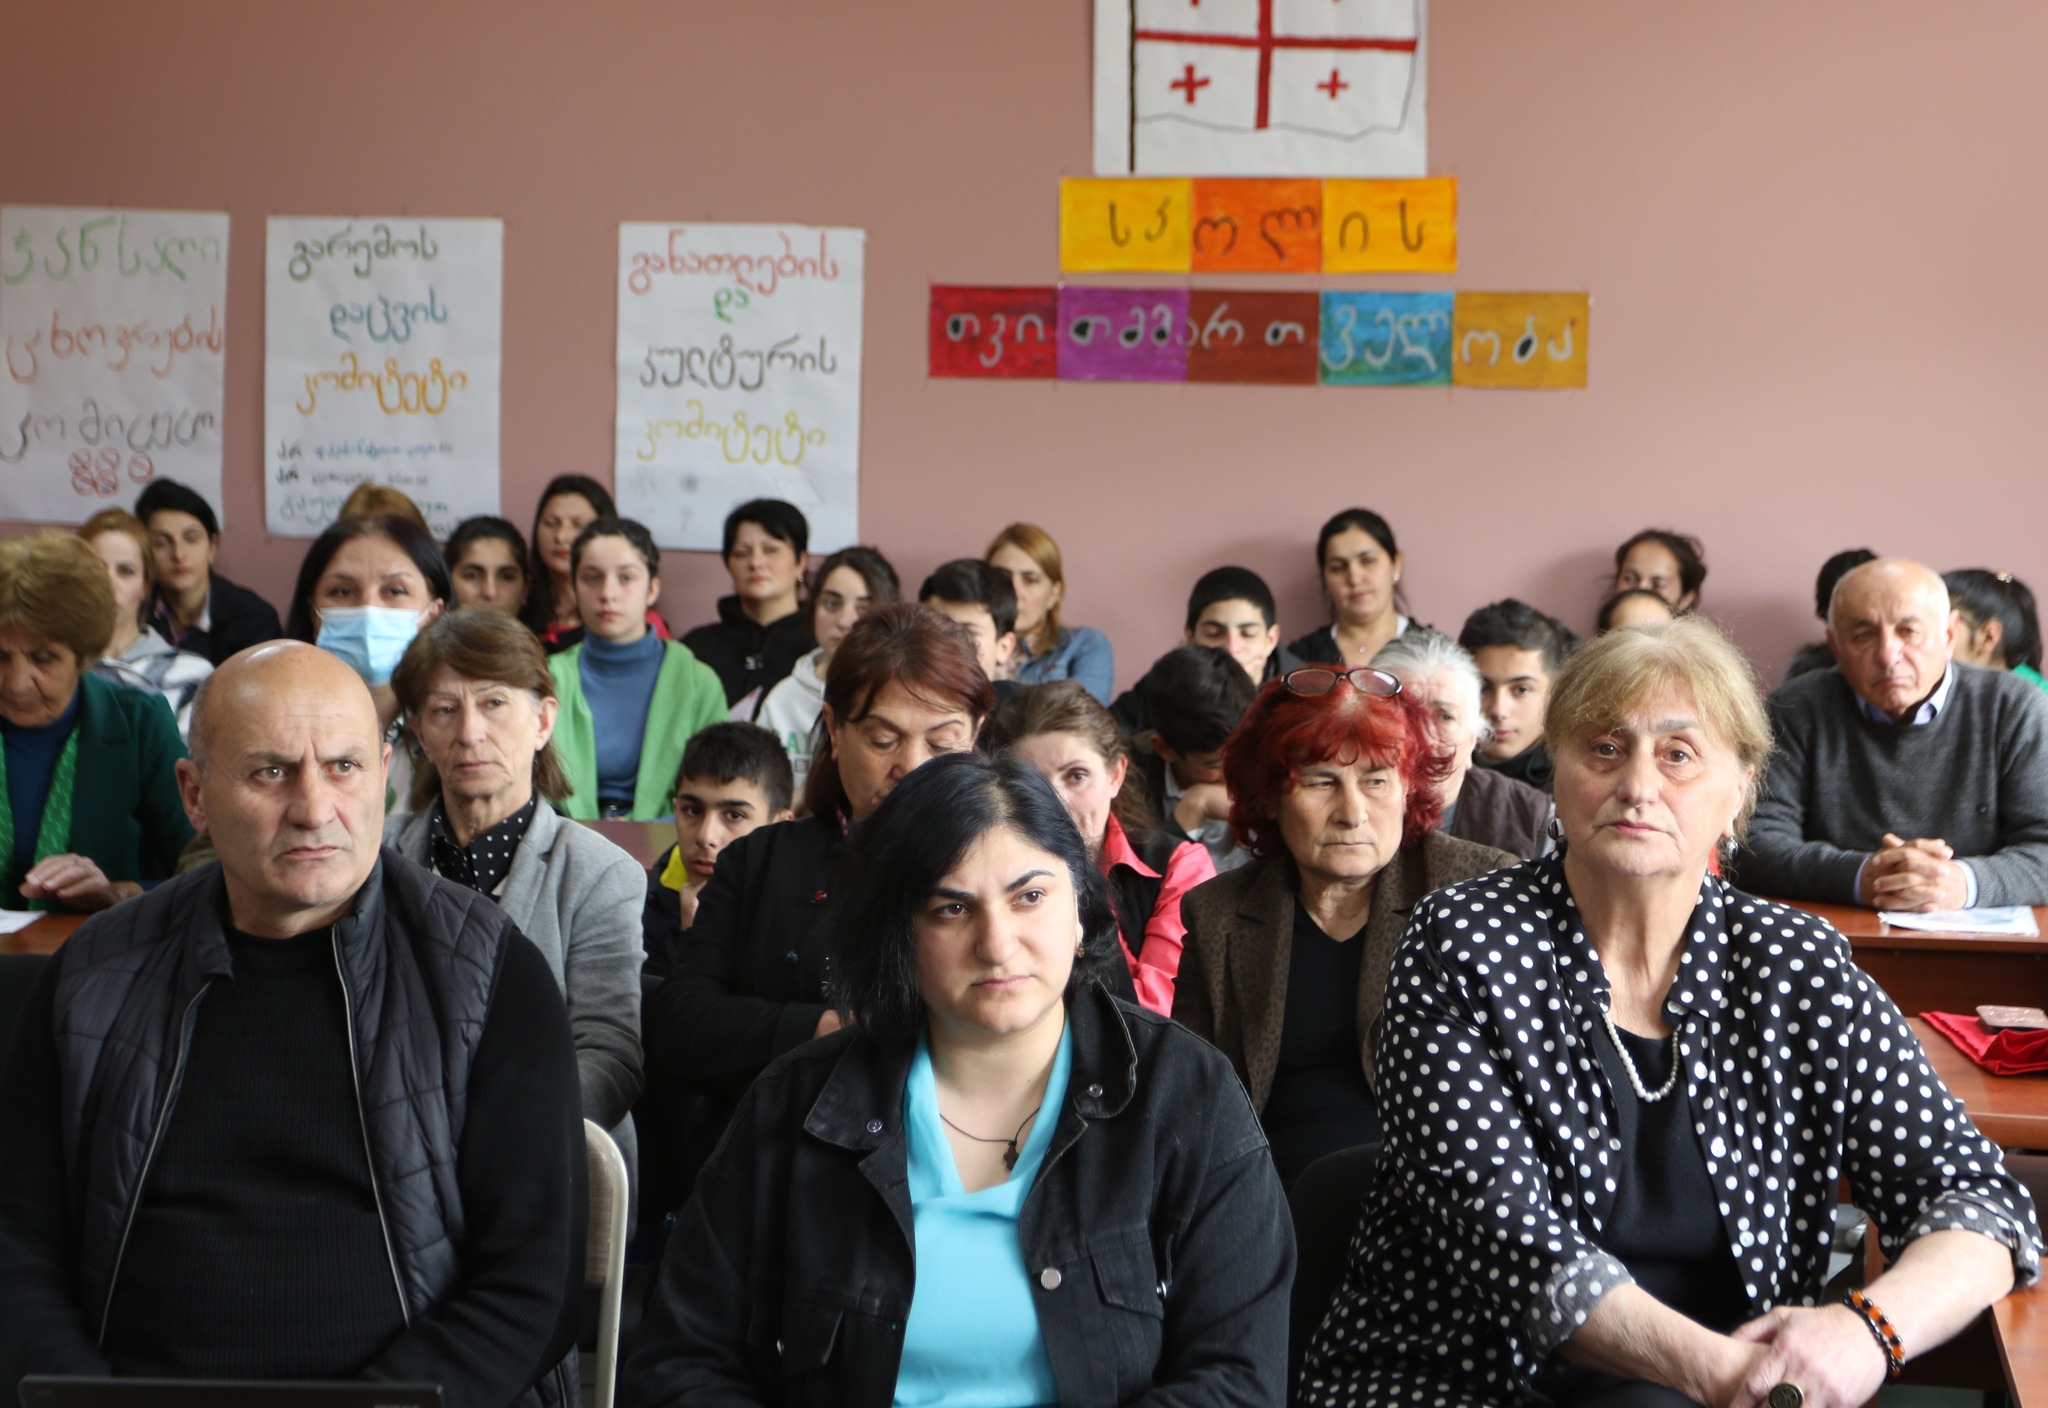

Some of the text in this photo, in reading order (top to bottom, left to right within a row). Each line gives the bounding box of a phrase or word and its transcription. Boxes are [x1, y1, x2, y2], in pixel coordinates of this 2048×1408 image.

[287, 222, 440, 283] გარემოს
[1106, 196, 1427, 263] სკოლის
[627, 227, 840, 297] განათლების
[328, 284, 448, 344] დაცვის
[712, 286, 751, 325] და
[294, 350, 469, 416] კომიტეტი
[638, 332, 838, 392] კულტურის
[635, 397, 828, 467] კომიტეტი
